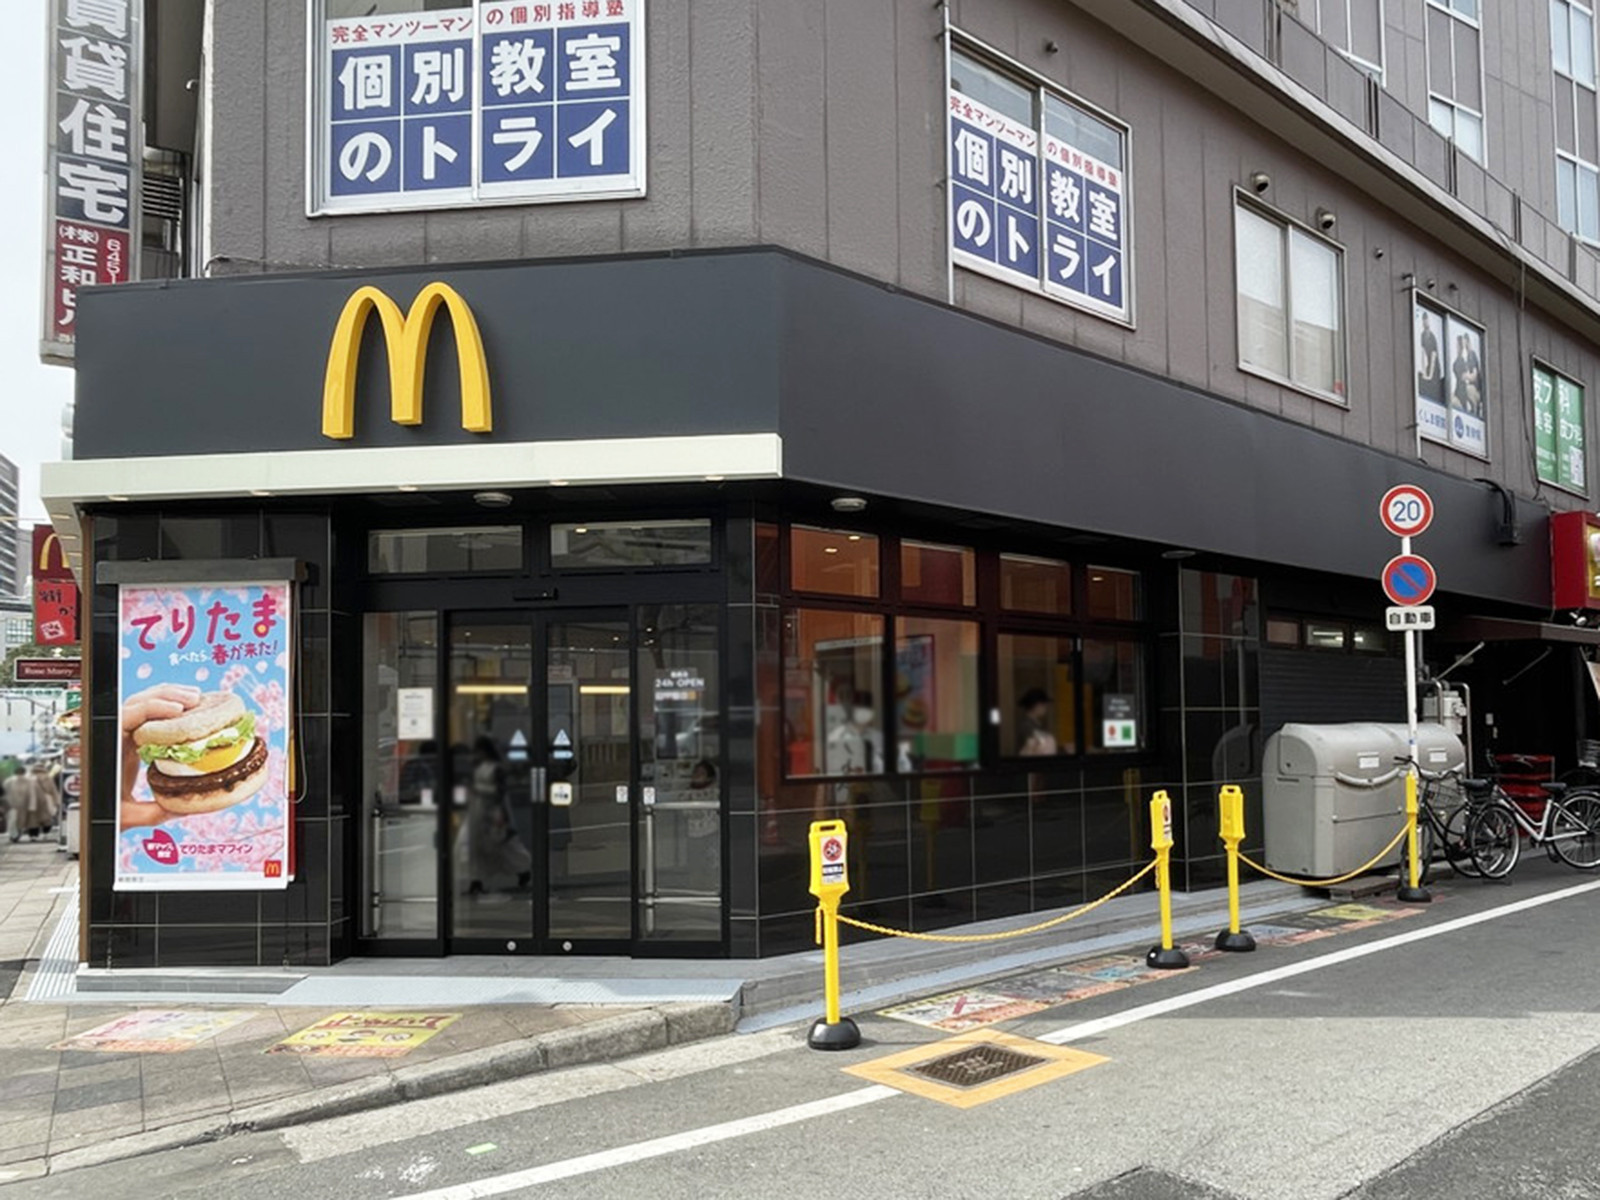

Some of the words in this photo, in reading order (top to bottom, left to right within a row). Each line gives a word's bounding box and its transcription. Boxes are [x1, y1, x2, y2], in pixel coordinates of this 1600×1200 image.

[338, 33, 621, 111] 個別教室
[339, 108, 617, 183] のトライ
[955, 128, 1118, 241] 個別教室
[957, 199, 1118, 296] のトライ
[1392, 500, 1421, 522] 20
[131, 594, 277, 651] てりたま
[1389, 612, 1432, 625] 自動車
[212, 640, 278, 665] 春が来た!
[677, 678, 704, 688] OPEN
[181, 843, 253, 855] てりたまマフィン
